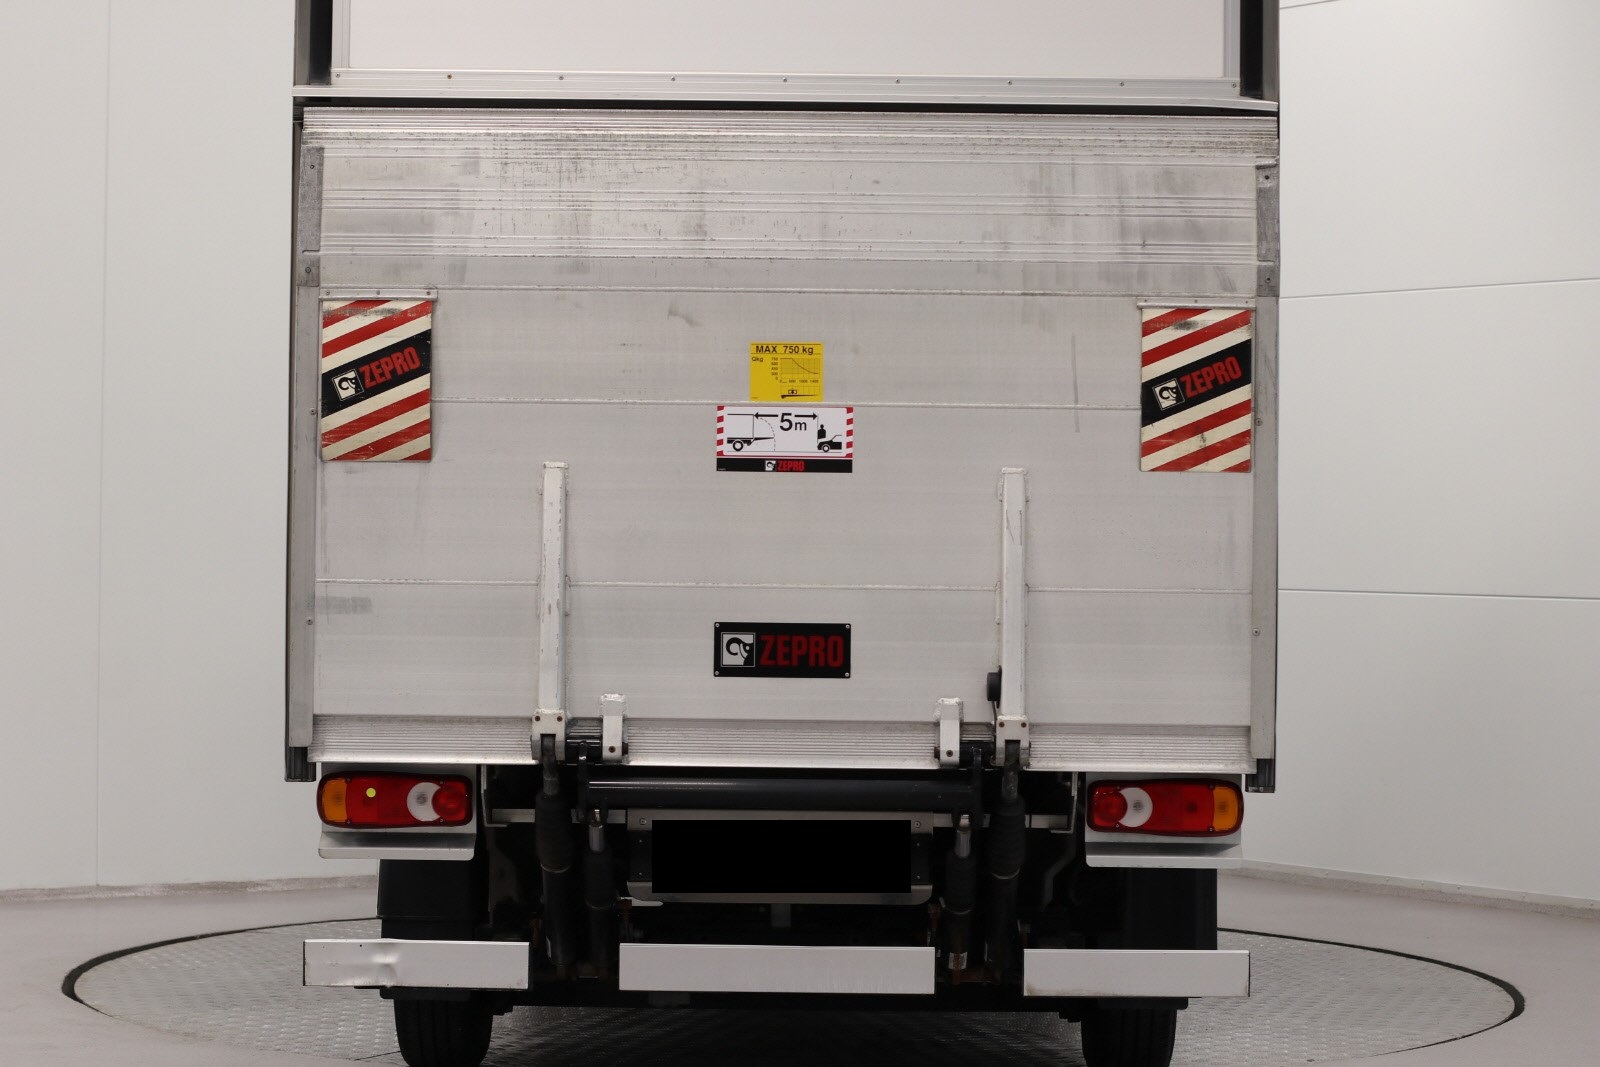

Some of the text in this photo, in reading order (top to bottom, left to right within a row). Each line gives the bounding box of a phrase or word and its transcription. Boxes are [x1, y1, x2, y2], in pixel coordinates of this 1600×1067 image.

[755, 345, 814, 355] MAX 750 kg
[360, 346, 421, 389] ZEPRO
[1180, 356, 1242, 399] ZEPRO
[777, 460, 805, 472] ZEPRO
[760, 635, 844, 667] ZEPRO
